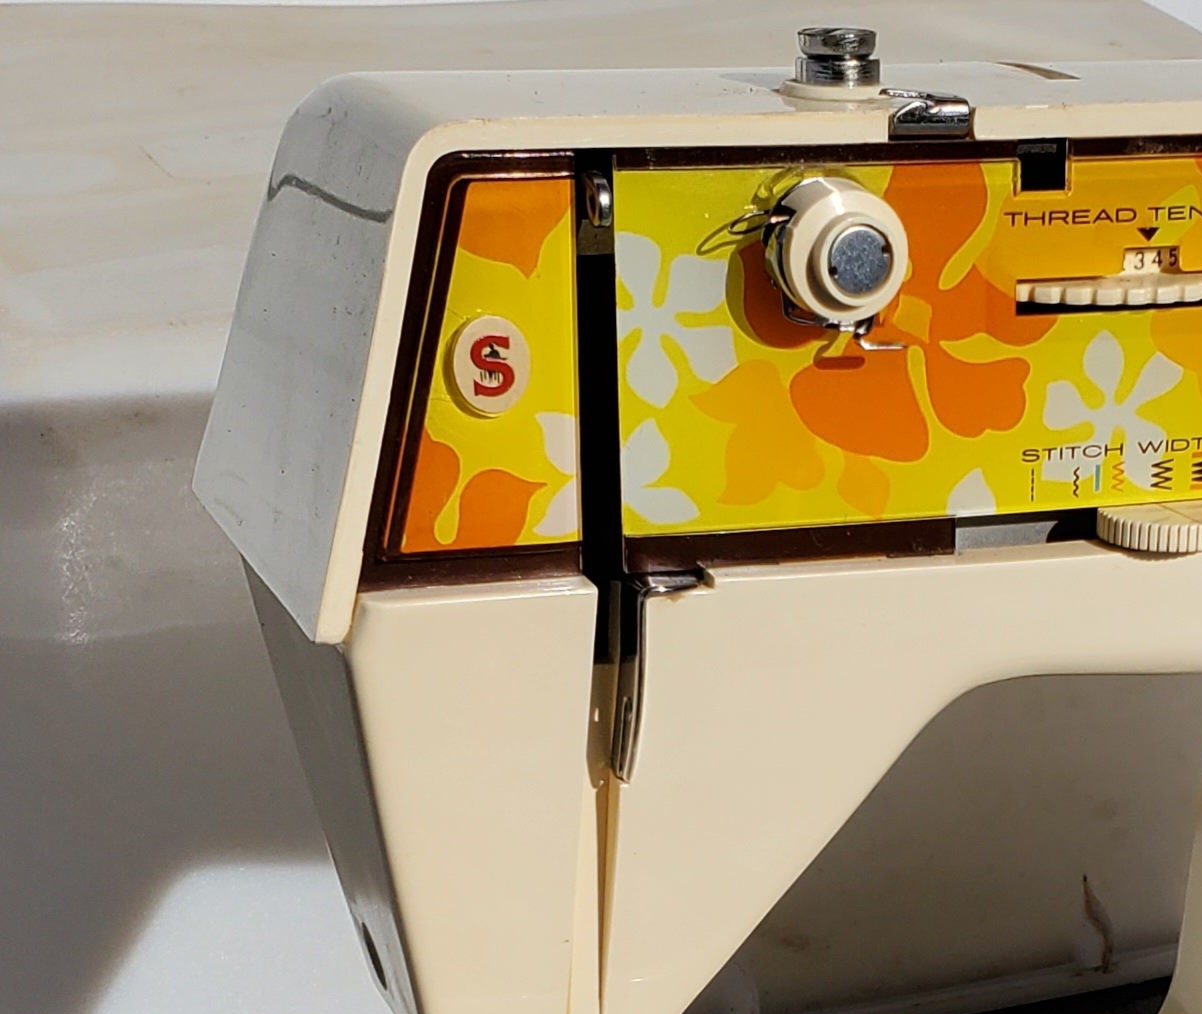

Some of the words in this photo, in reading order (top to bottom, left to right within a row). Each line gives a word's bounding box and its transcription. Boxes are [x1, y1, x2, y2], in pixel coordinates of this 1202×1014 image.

[1003, 207, 1137, 227] THREAD
[1133, 251, 1144, 270] 3
[1152, 249, 1162, 268] 4
[1169, 247, 1177, 267] 5
[470, 335, 515, 397] S
[1021, 443, 1124, 463] STITCH
